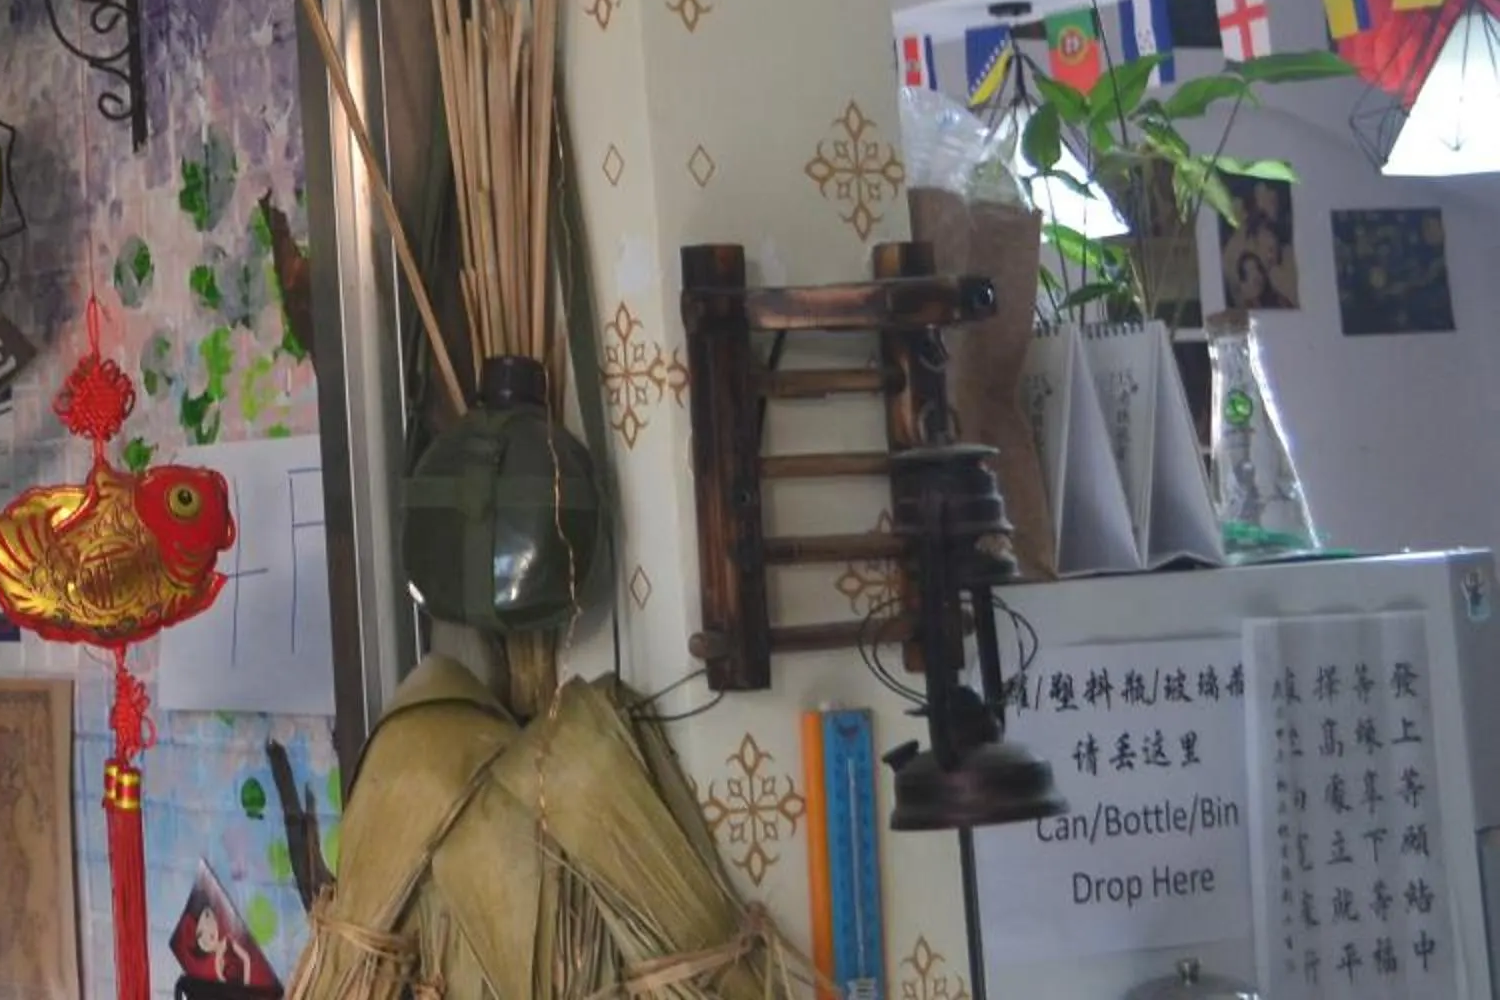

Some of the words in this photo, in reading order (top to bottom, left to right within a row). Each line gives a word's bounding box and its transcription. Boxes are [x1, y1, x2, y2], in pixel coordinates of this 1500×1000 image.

[1073, 729, 1201, 776] 请丢这里
[1036, 793, 1240, 844] Can/Bottle/Bin
[1072, 871, 1143, 908] Drop
[1152, 865, 1215, 899] Here
